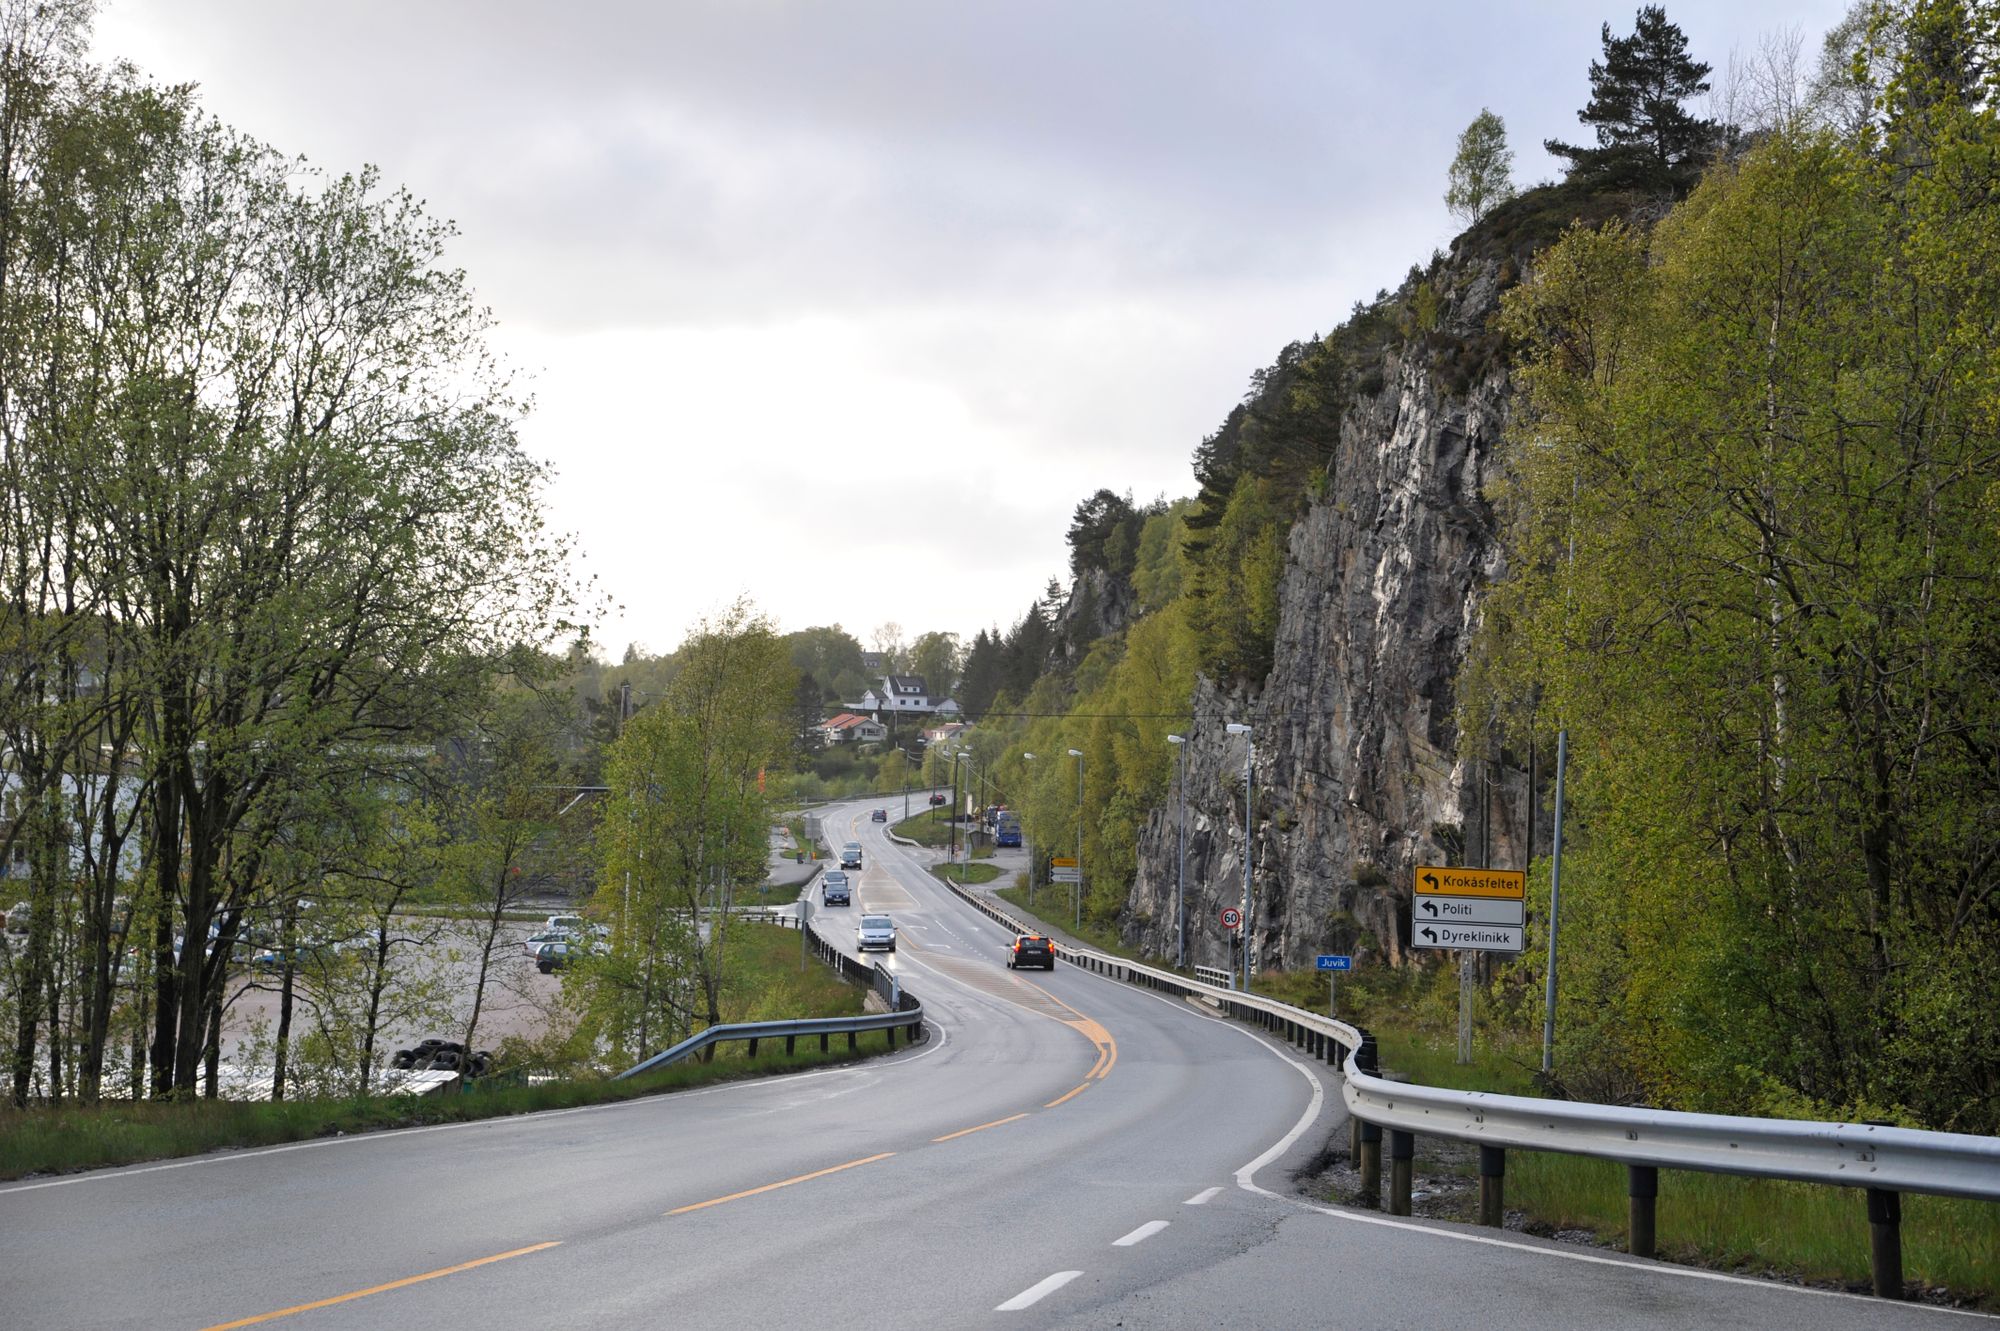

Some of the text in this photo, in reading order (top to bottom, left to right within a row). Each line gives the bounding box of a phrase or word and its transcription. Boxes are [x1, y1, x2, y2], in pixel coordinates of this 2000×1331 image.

[1443, 875, 1519, 889] Krokåsfeltet
[1442, 903, 1472, 915] Politi
[1224, 913, 1237, 923] 60
[1442, 929, 1510, 944] Dyreklinikk
[1321, 958, 1346, 967] Juvik
